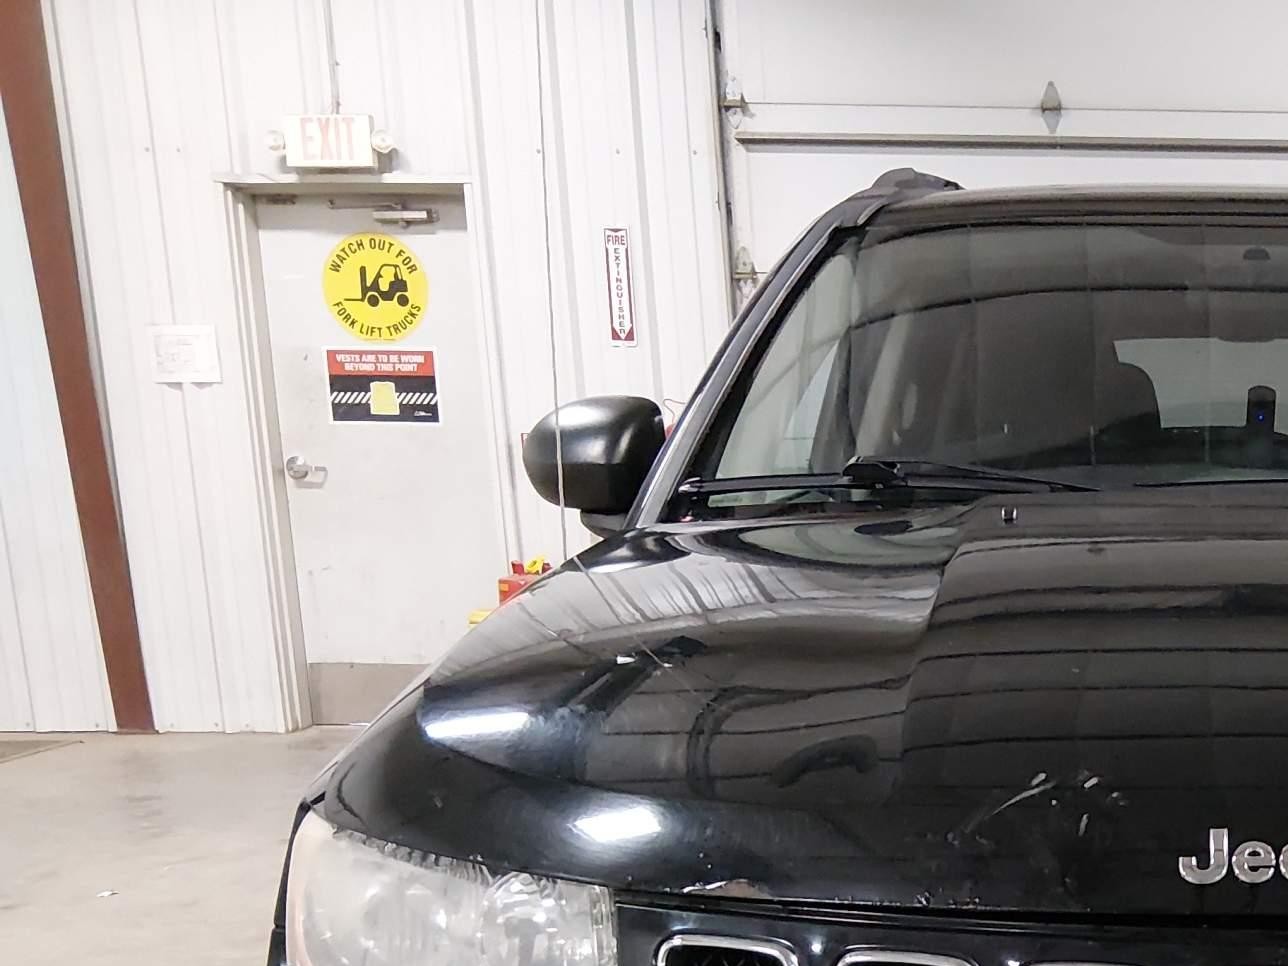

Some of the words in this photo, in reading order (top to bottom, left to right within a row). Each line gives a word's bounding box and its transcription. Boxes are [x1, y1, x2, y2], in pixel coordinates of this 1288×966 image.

[300, 117, 354, 161] EXIT
[606, 234, 626, 246] FIRE
[329, 238, 366, 274] WATCH
[368, 237, 395, 254] OUT
[395, 248, 419, 275] FOR
[332, 301, 359, 330] FORK
[359, 322, 383, 338] LIFT
[385, 303, 422, 338] TRUCKS
[335, 353, 361, 363] VESTS
[361, 353, 377, 363] ARE
[377, 354, 388, 363] TO
[388, 354, 401, 363] BE
[400, 355, 425, 364] WORN
[344, 362, 376, 371] BEYOND
[376, 363, 394, 372] THIS
[394, 363, 418, 372] POINT
